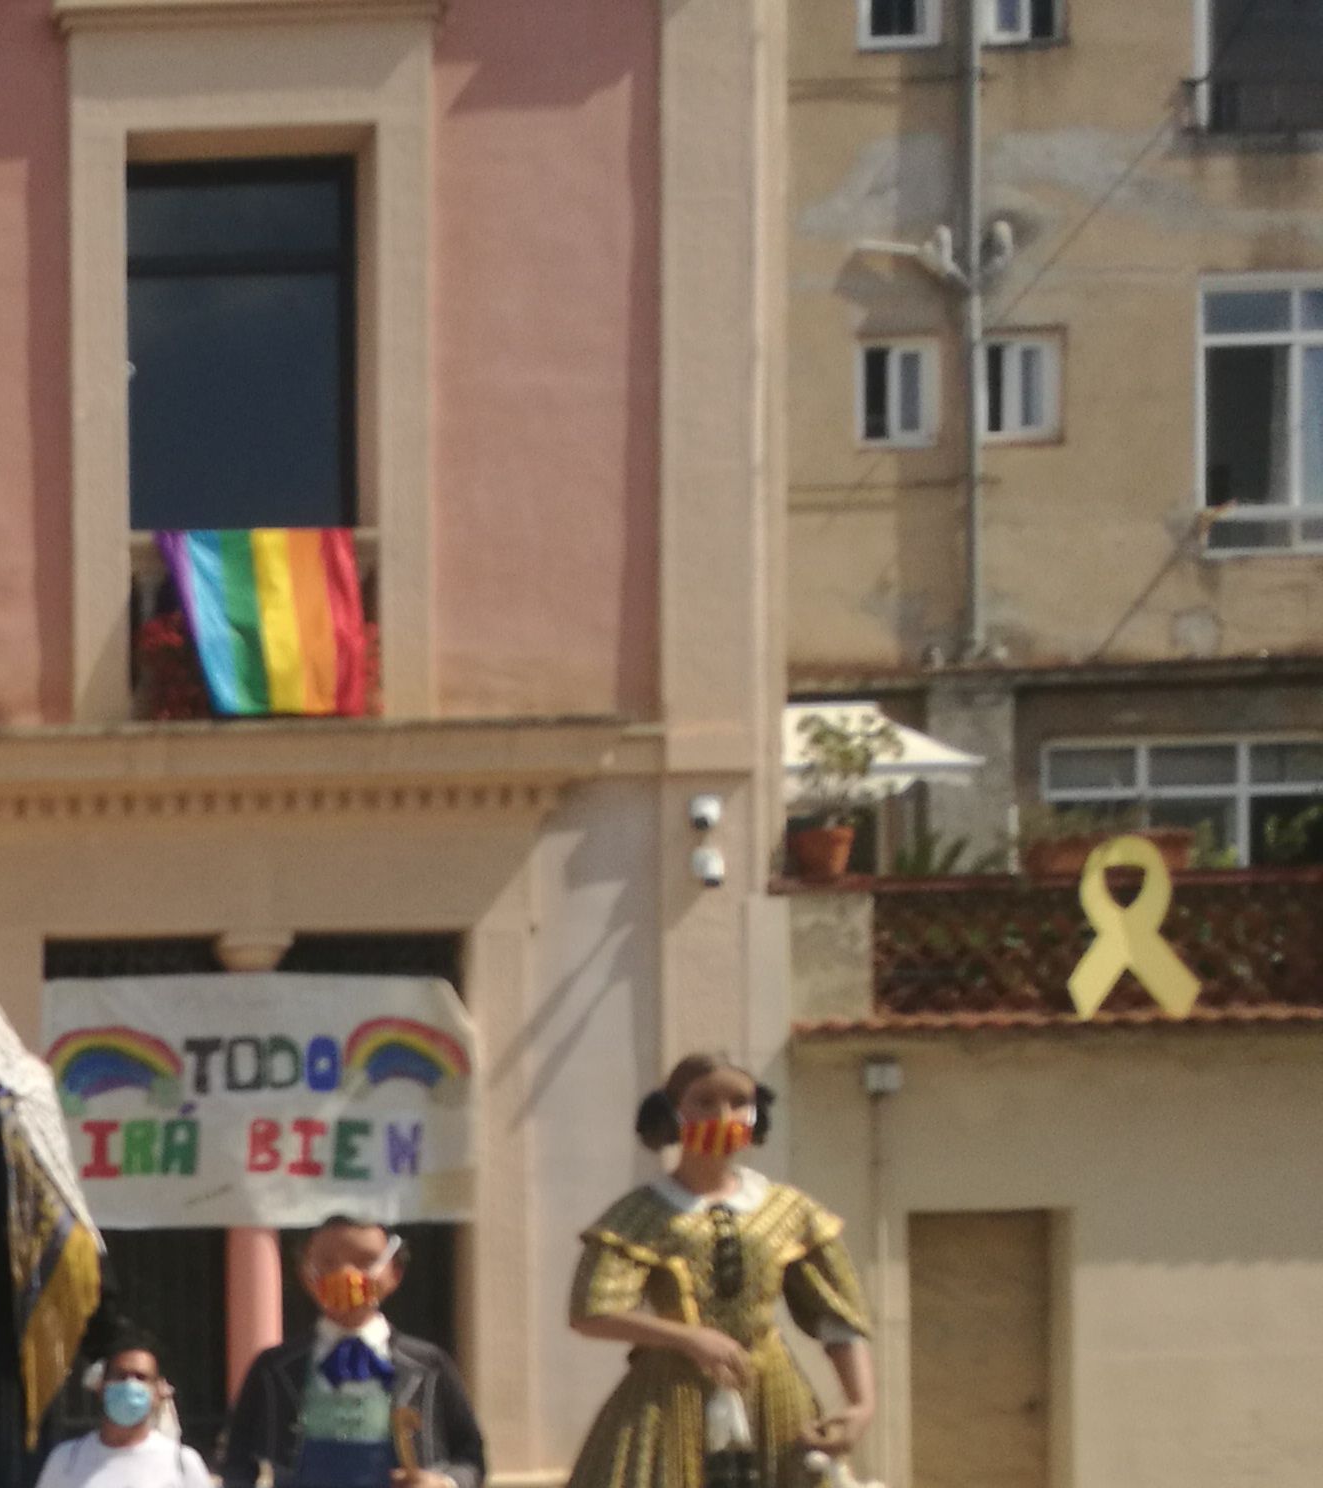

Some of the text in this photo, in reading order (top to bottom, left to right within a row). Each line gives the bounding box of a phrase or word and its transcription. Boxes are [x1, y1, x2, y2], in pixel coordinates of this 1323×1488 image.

[184, 1035, 341, 1093] TODO
[81, 1103, 422, 1179] IRÁ BIEN
